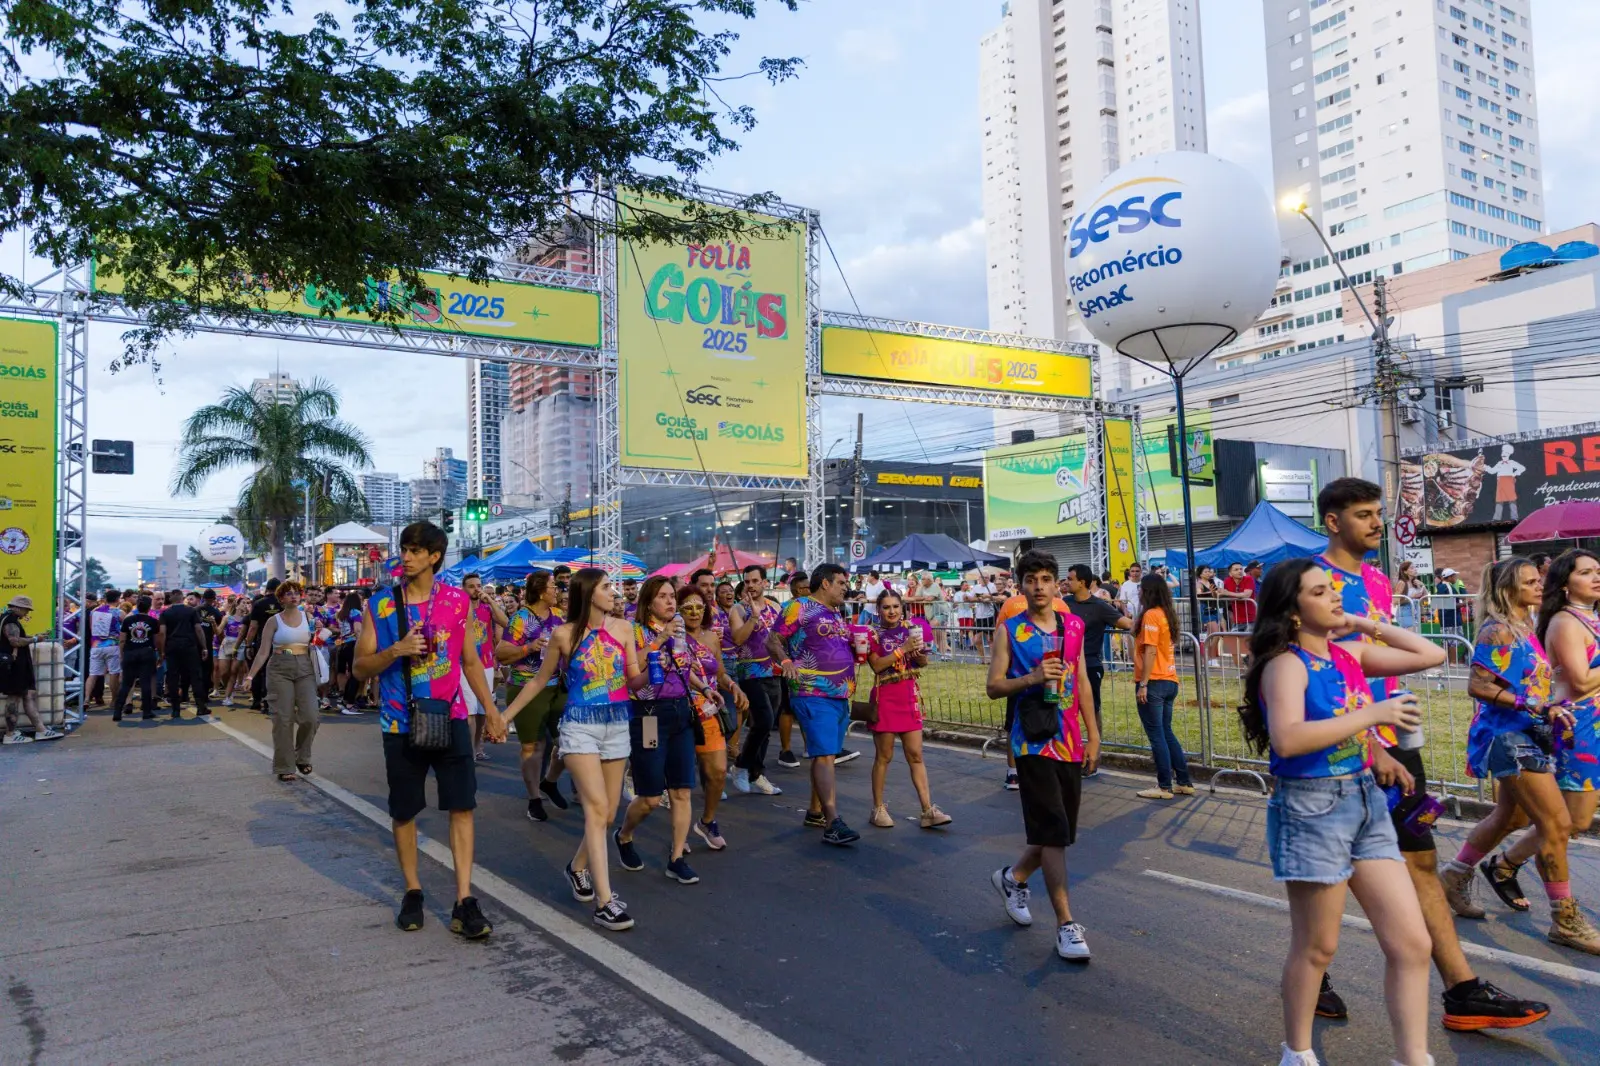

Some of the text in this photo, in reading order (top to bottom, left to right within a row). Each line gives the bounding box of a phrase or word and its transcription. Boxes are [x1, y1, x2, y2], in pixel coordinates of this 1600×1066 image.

[1069, 245, 1183, 295] Fecomércio
[447, 291, 506, 320] 2025
[644, 262, 788, 340] GOIÁS
[702, 327, 748, 353] 2025
[1006, 360, 1038, 380] 2025
[0, 401, 29, 410] oiás
[1, 409, 38, 419] social
[656, 412, 697, 429] Goiás
[666, 427, 708, 441] social
[731, 423, 785, 442] GOIÁS
[1543, 436, 1600, 477] RE
